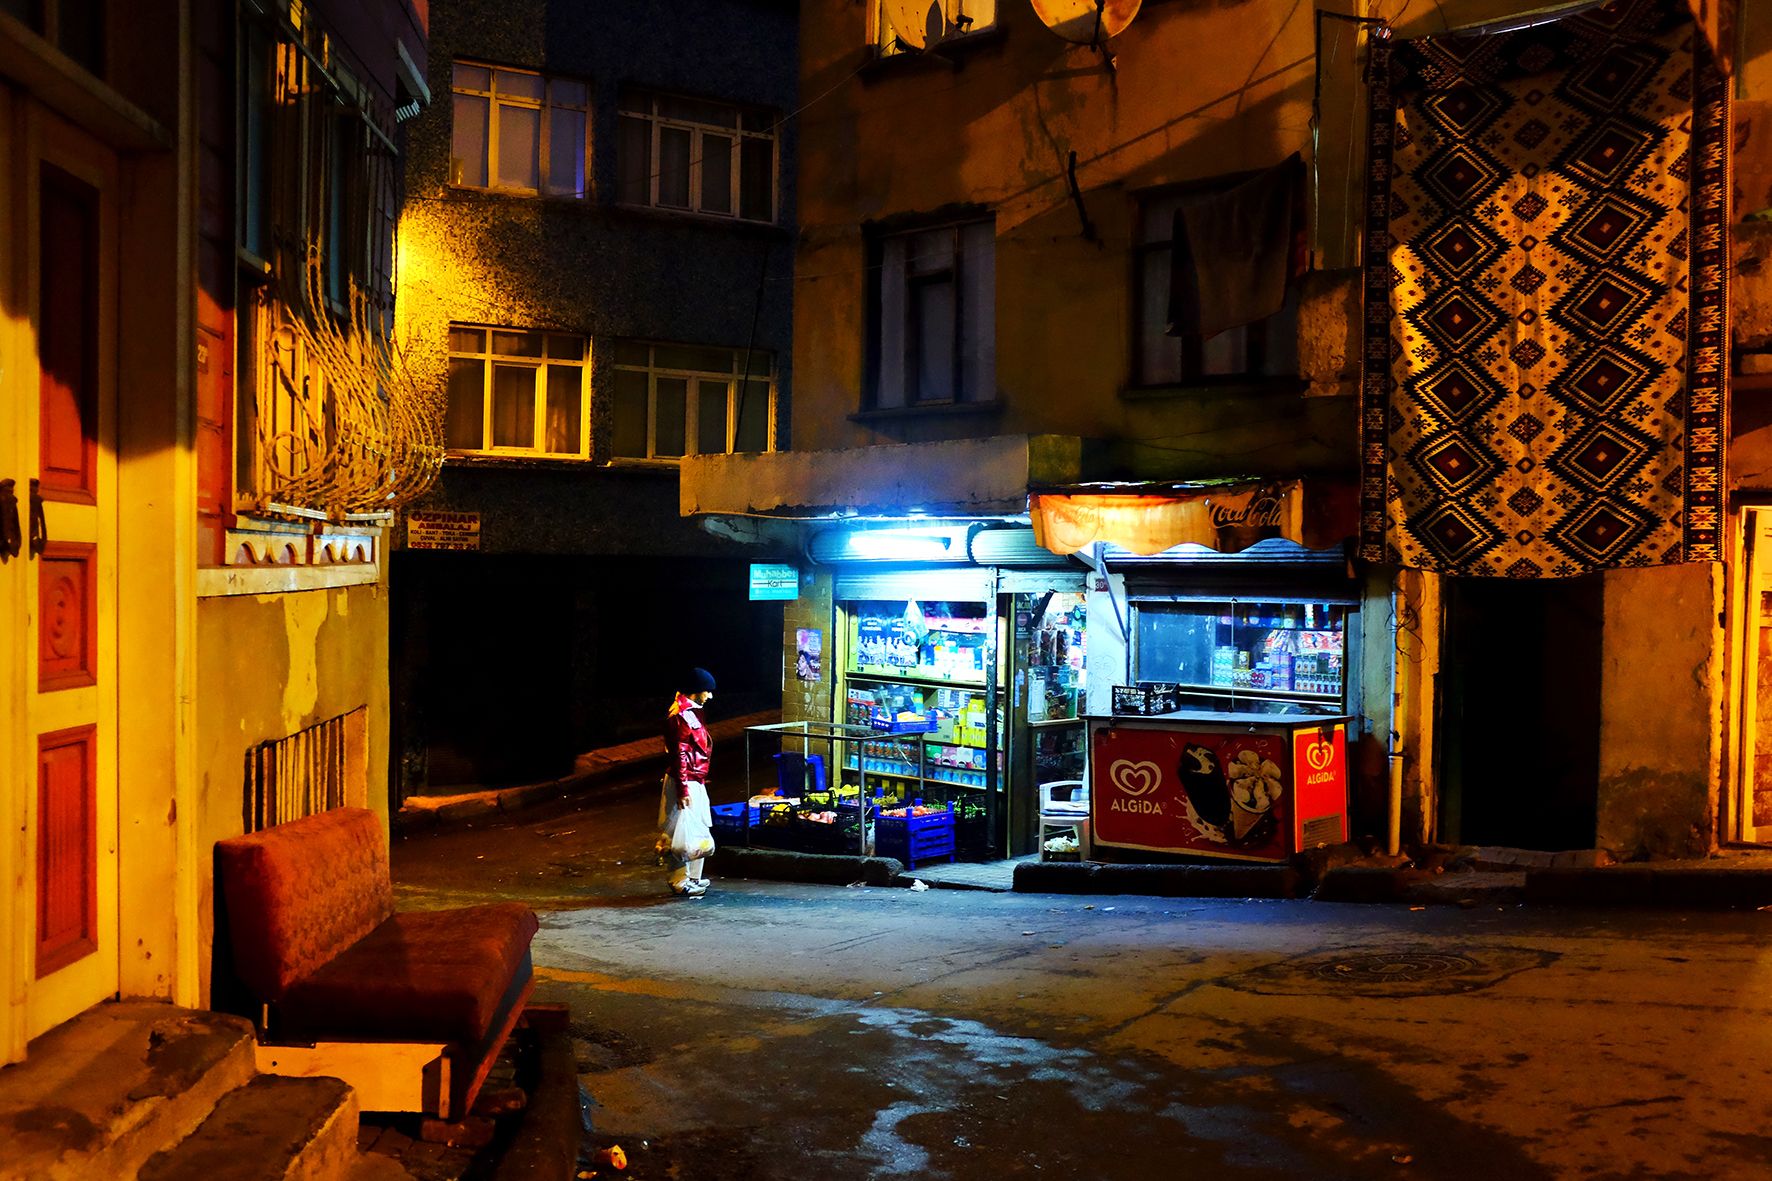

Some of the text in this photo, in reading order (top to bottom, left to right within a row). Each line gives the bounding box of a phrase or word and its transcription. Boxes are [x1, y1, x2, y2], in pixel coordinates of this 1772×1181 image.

[418, 523, 472, 531] AMBALAJ
[753, 569, 796, 579] Muhabbet
[768, 580, 782, 588] Kart
